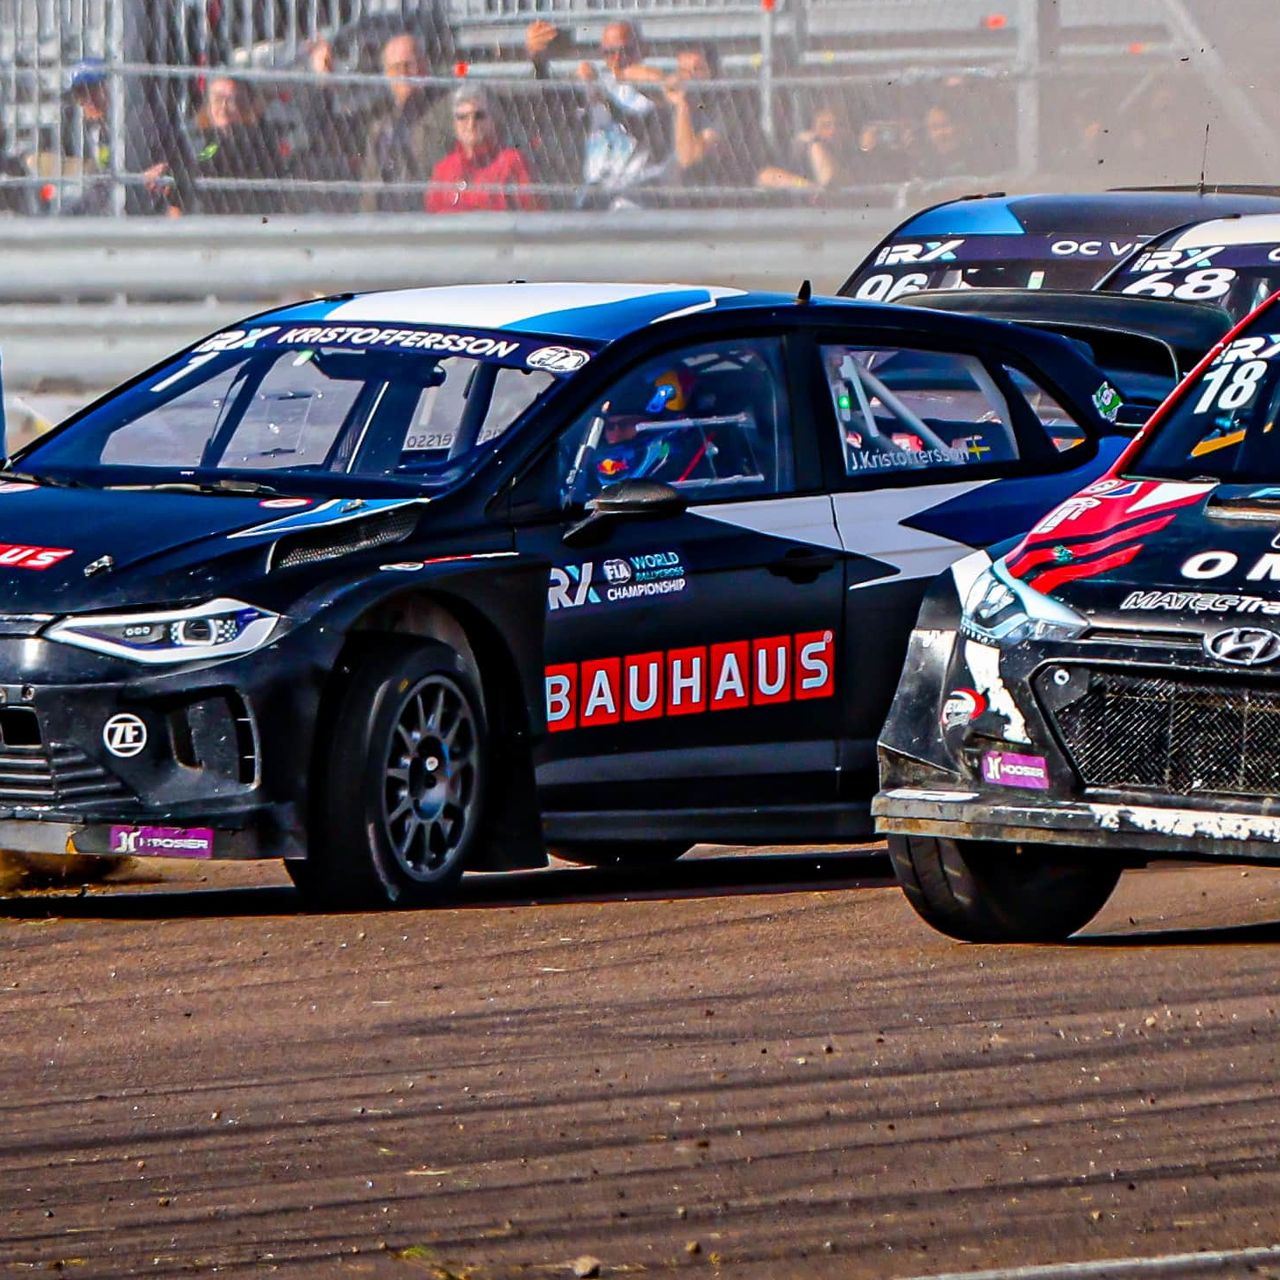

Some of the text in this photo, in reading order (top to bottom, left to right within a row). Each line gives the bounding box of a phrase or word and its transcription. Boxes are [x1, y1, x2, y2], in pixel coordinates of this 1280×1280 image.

[1051, 240, 1102, 255] OC
[1122, 269, 1236, 300] 68
[278, 327, 519, 358] KRISTOFFERSSON
[150, 351, 219, 392] 1
[529, 349, 584, 369] FIA
[1194, 361, 1267, 414] 18
[604, 551, 679, 581] FIA WORLD
[608, 578, 685, 600] CHAMPIONSHIP
[106, 723, 144, 751] ZF
